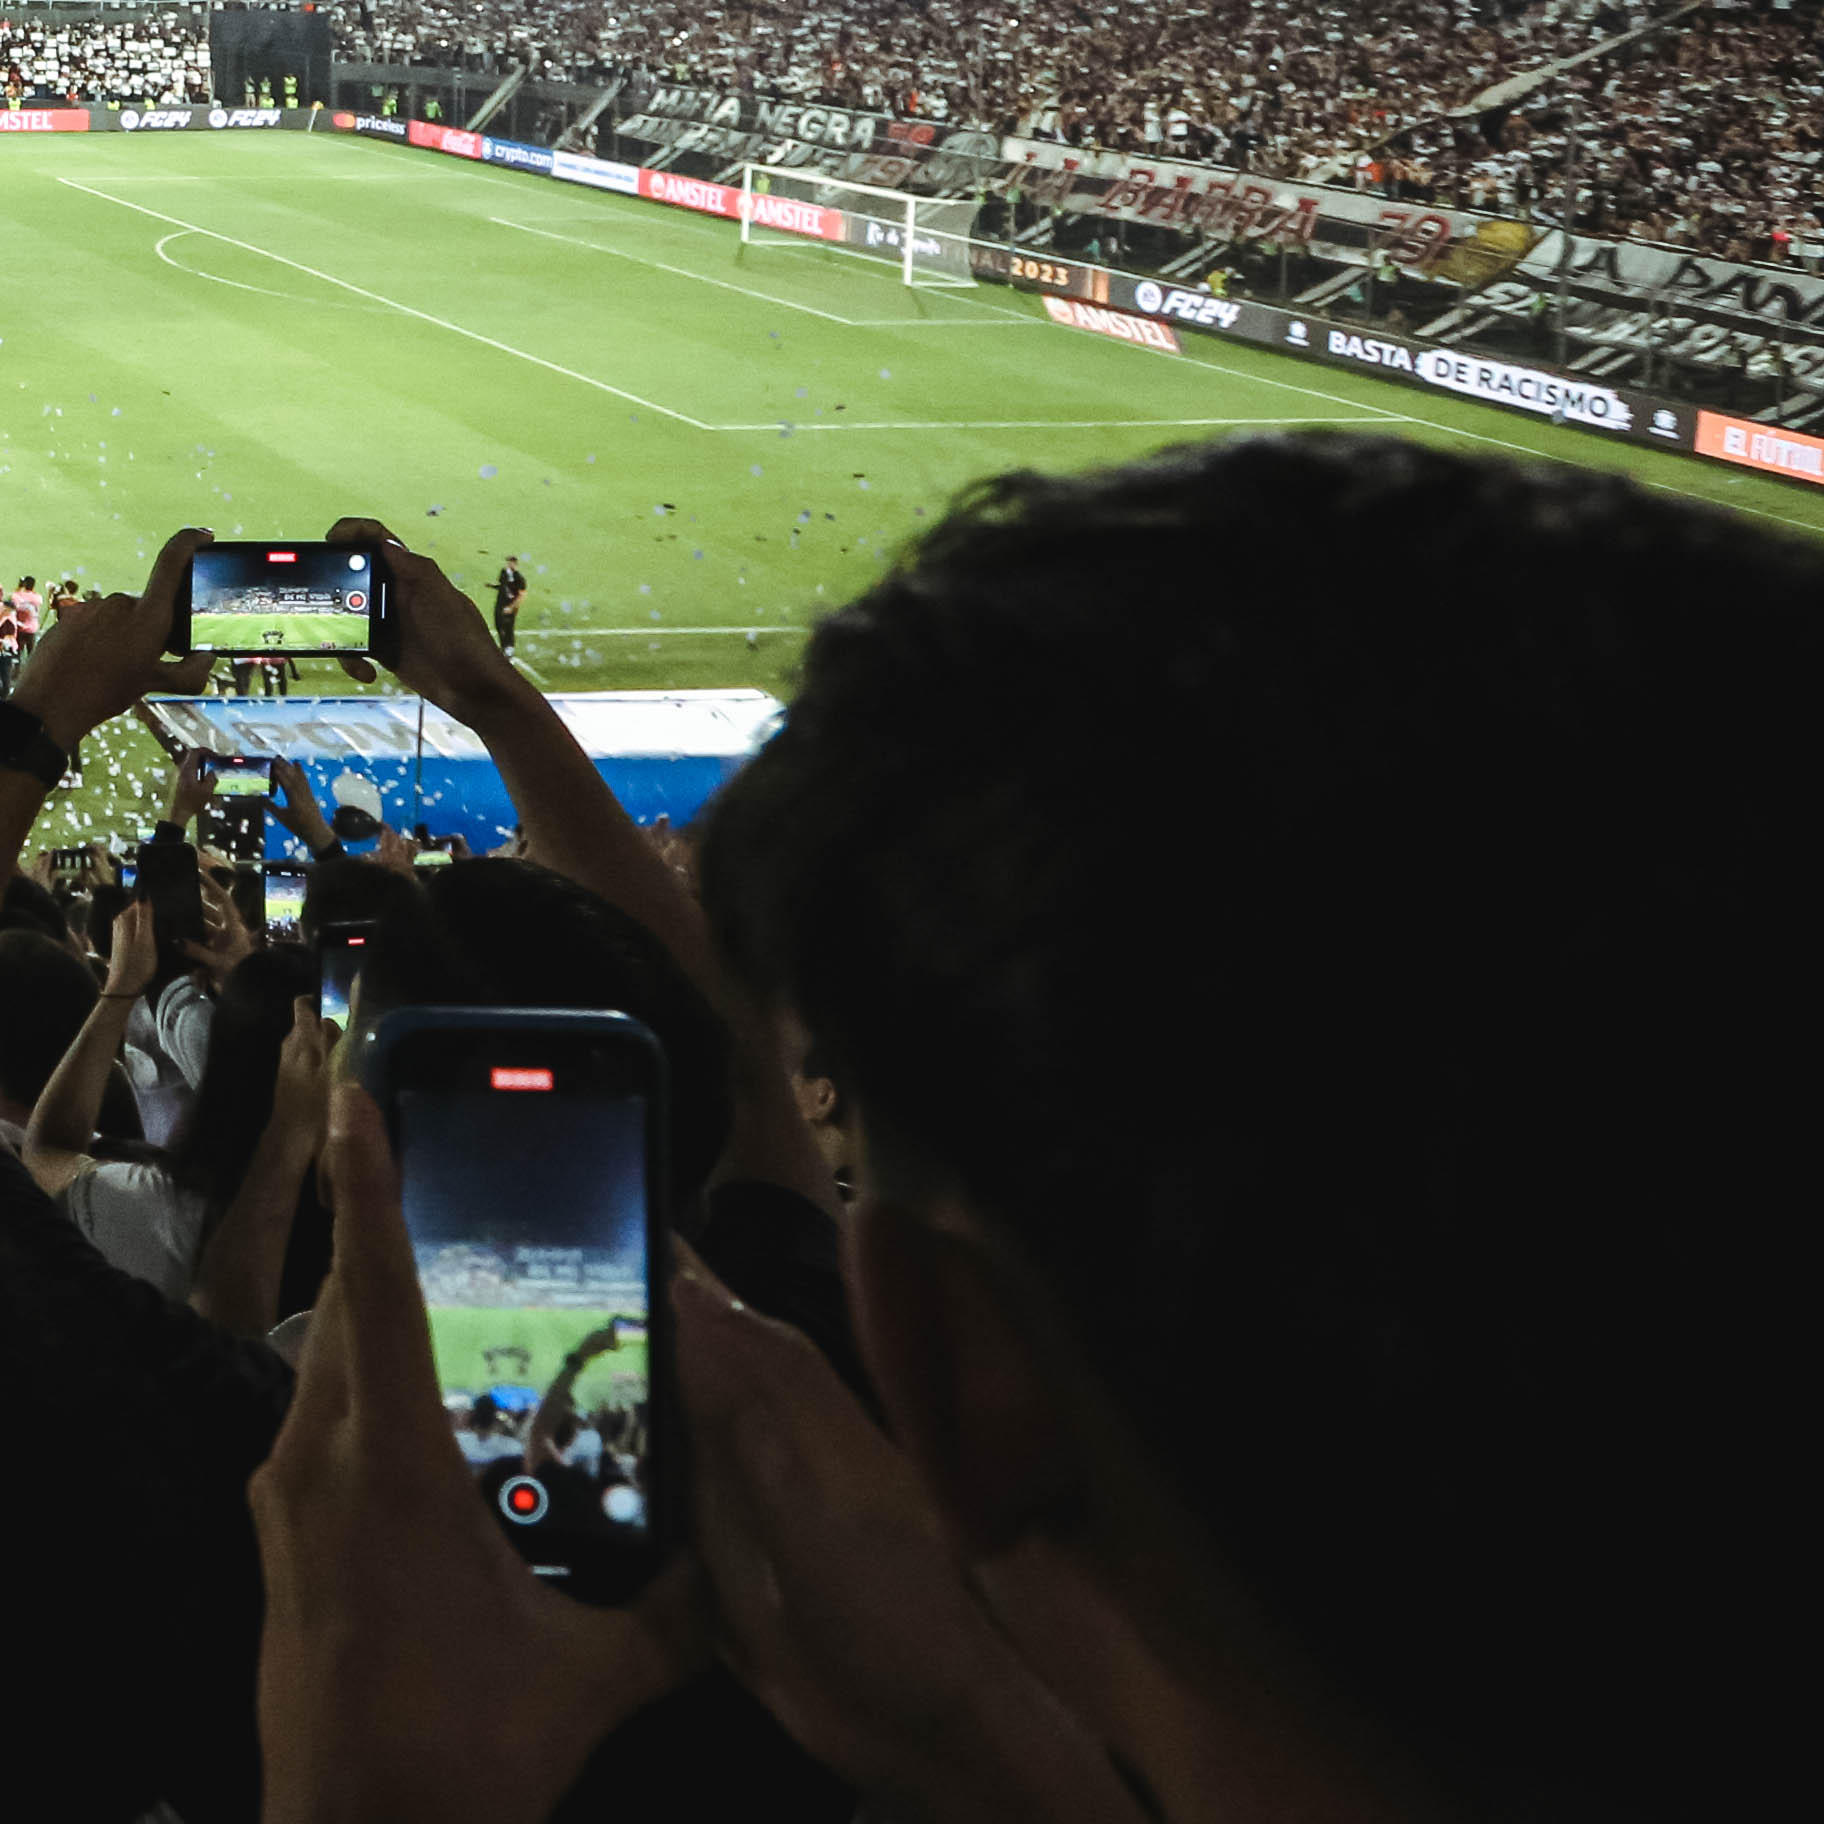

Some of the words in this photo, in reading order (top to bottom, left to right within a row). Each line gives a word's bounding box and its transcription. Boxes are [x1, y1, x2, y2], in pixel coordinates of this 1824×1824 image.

[139, 110, 192, 129] FC24
[228, 108, 281, 127] FC24
[664, 179, 727, 213] AMSTEL
[754, 199, 822, 234] AMSTEL
[1010, 257, 1069, 287] 2023
[1161, 290, 1240, 328] FC24
[1074, 306, 1178, 352] AMSTEL
[1328, 331, 1411, 371] BASTA
[1434, 358, 1468, 384] DE
[1478, 364, 1610, 418] RACISMO
